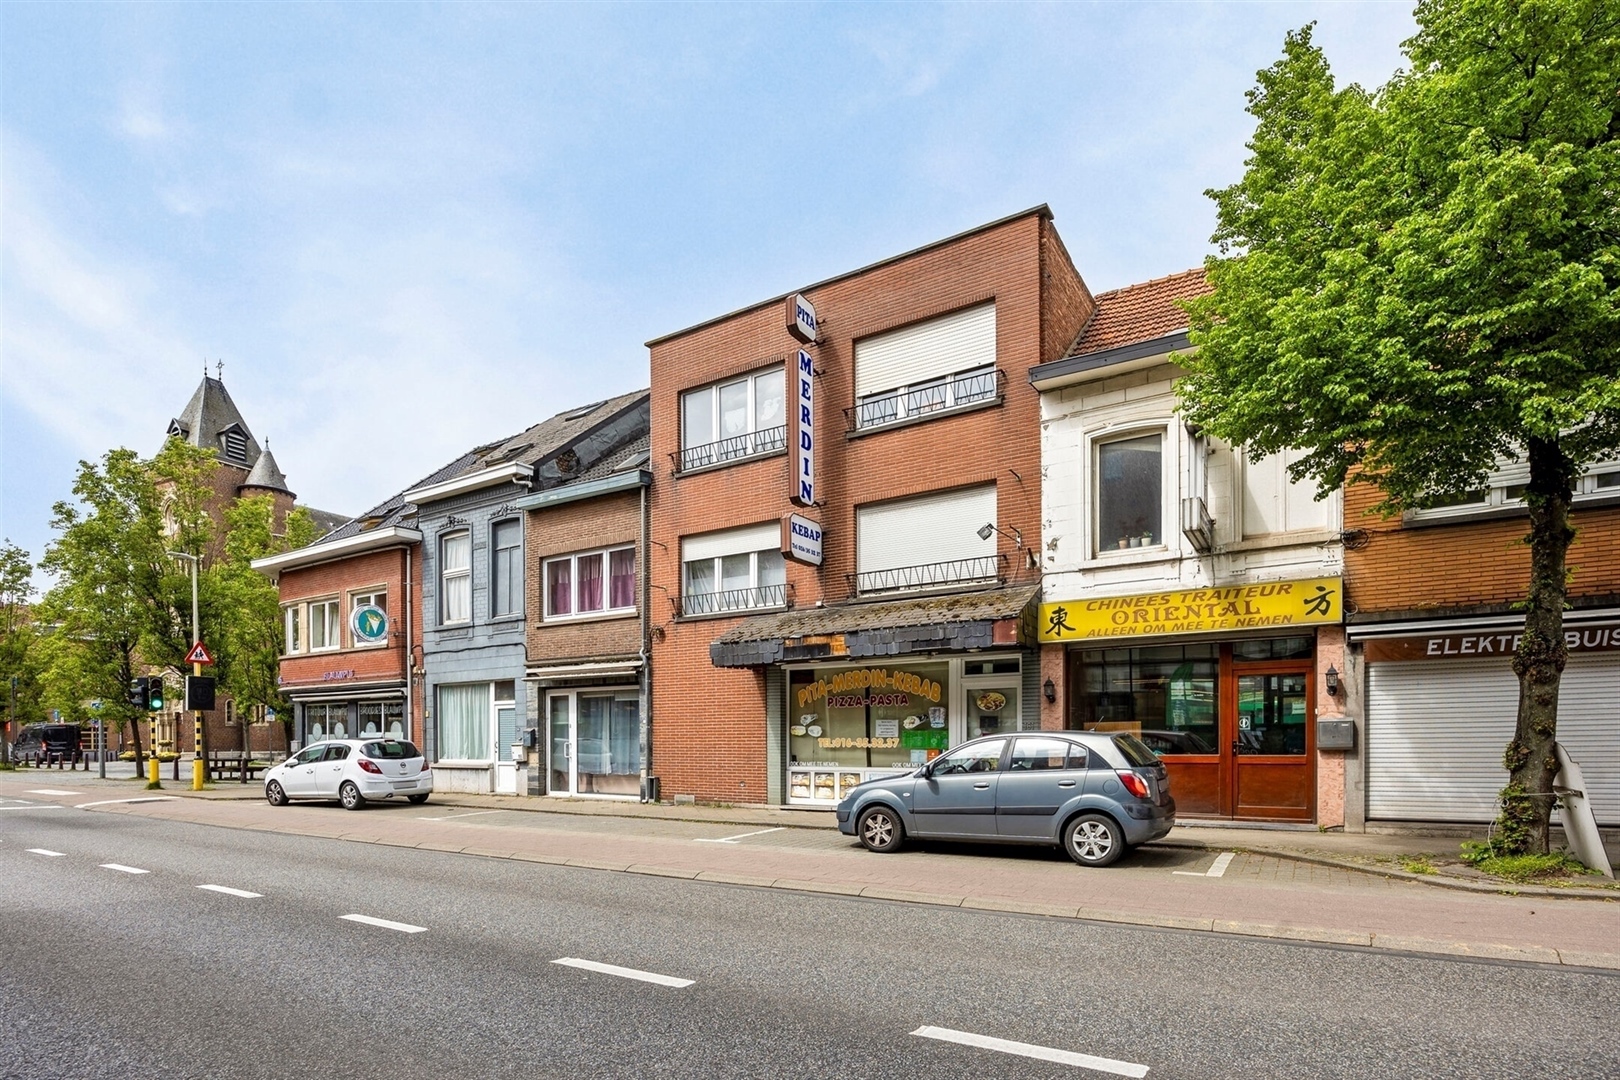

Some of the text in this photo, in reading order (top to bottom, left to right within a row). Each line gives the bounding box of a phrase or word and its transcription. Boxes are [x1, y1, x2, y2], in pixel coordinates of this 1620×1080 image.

[797, 304, 815, 330] PITA
[800, 352, 812, 501] MERDIN
[792, 522, 820, 542] KEBAP
[1086, 583, 1292, 612] CHINEES TRAITEUR
[1303, 587, 1335, 616] 方
[1045, 606, 1076, 636] 東
[1087, 615, 1292, 637] ALLEEN OM MEE TE NEMEN
[1111, 600, 1260, 625] ORIENTAL
[798, 669, 940, 707] PITA-MERDIN-KEBAB
[827, 694, 909, 708] PIZZA-PASTA
